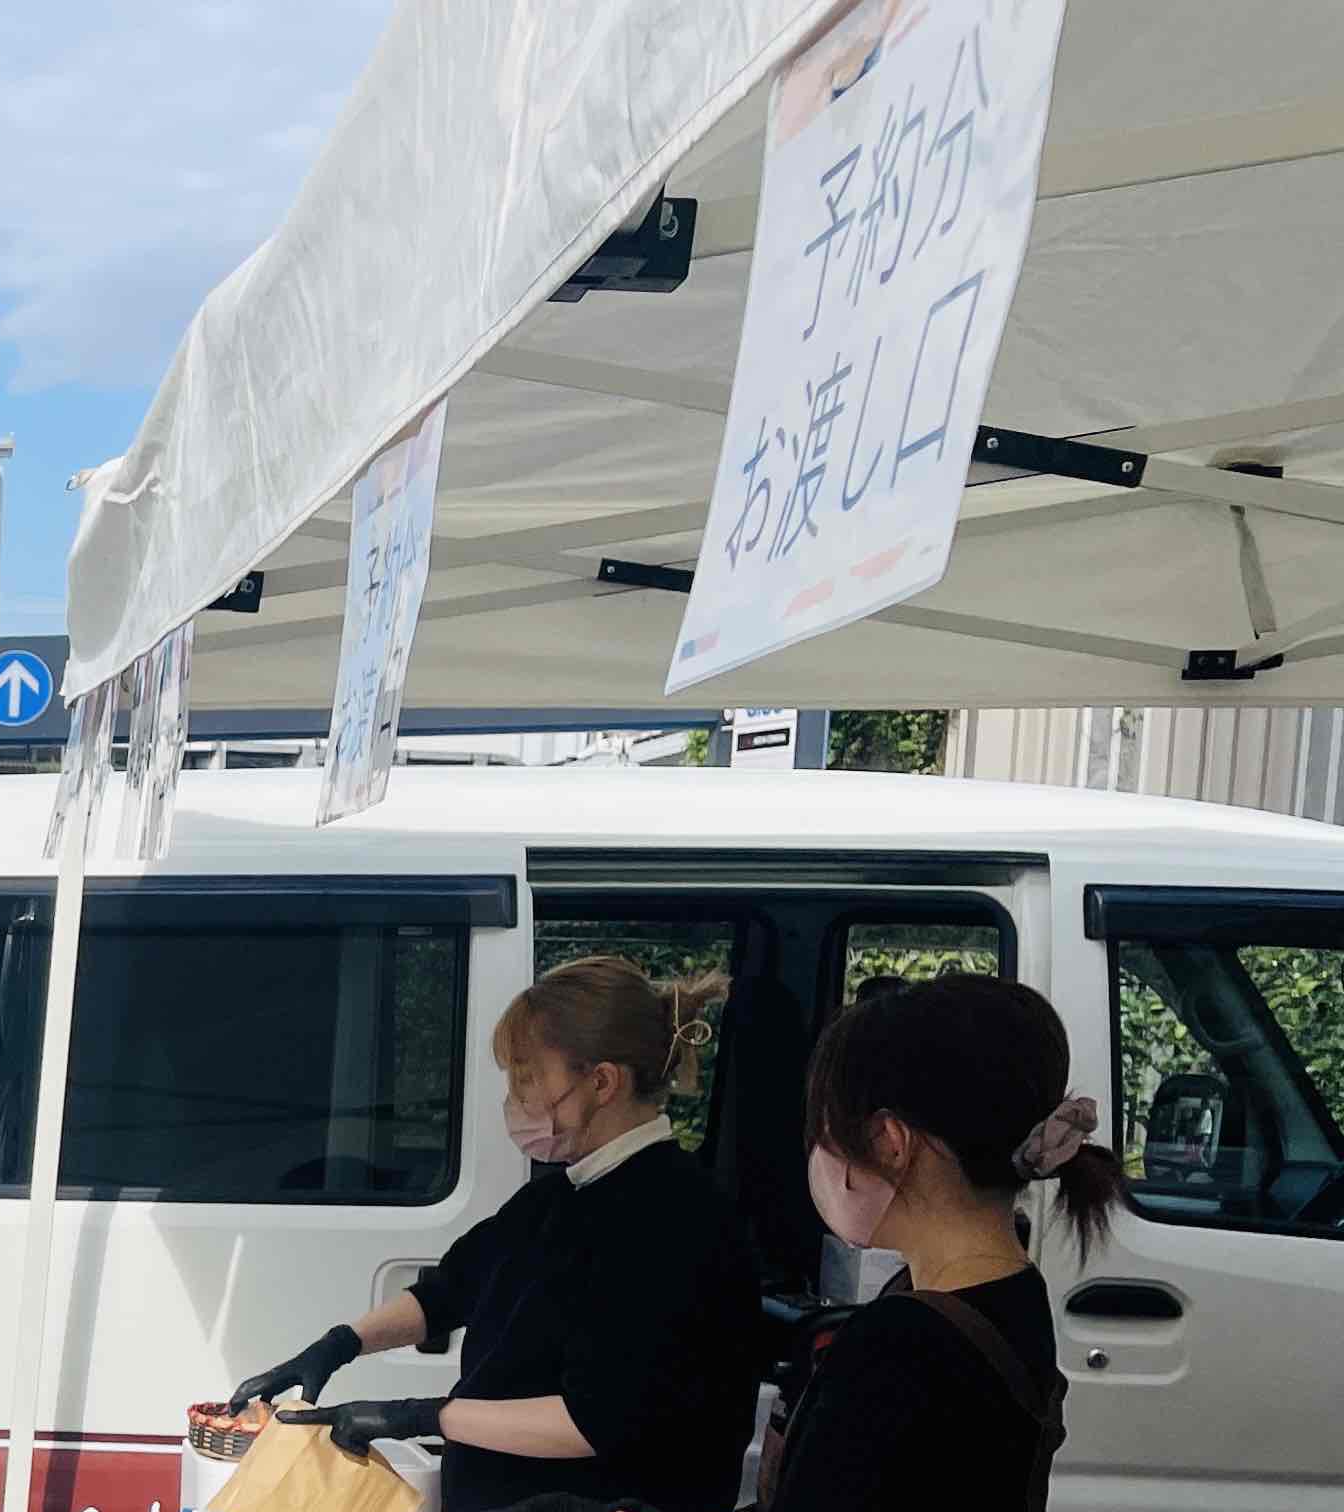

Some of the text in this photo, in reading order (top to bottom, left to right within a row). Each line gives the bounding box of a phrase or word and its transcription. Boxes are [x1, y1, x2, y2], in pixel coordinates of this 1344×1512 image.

[802, 24, 990, 342] 予約分
[724, 269, 986, 572] お渡し口
